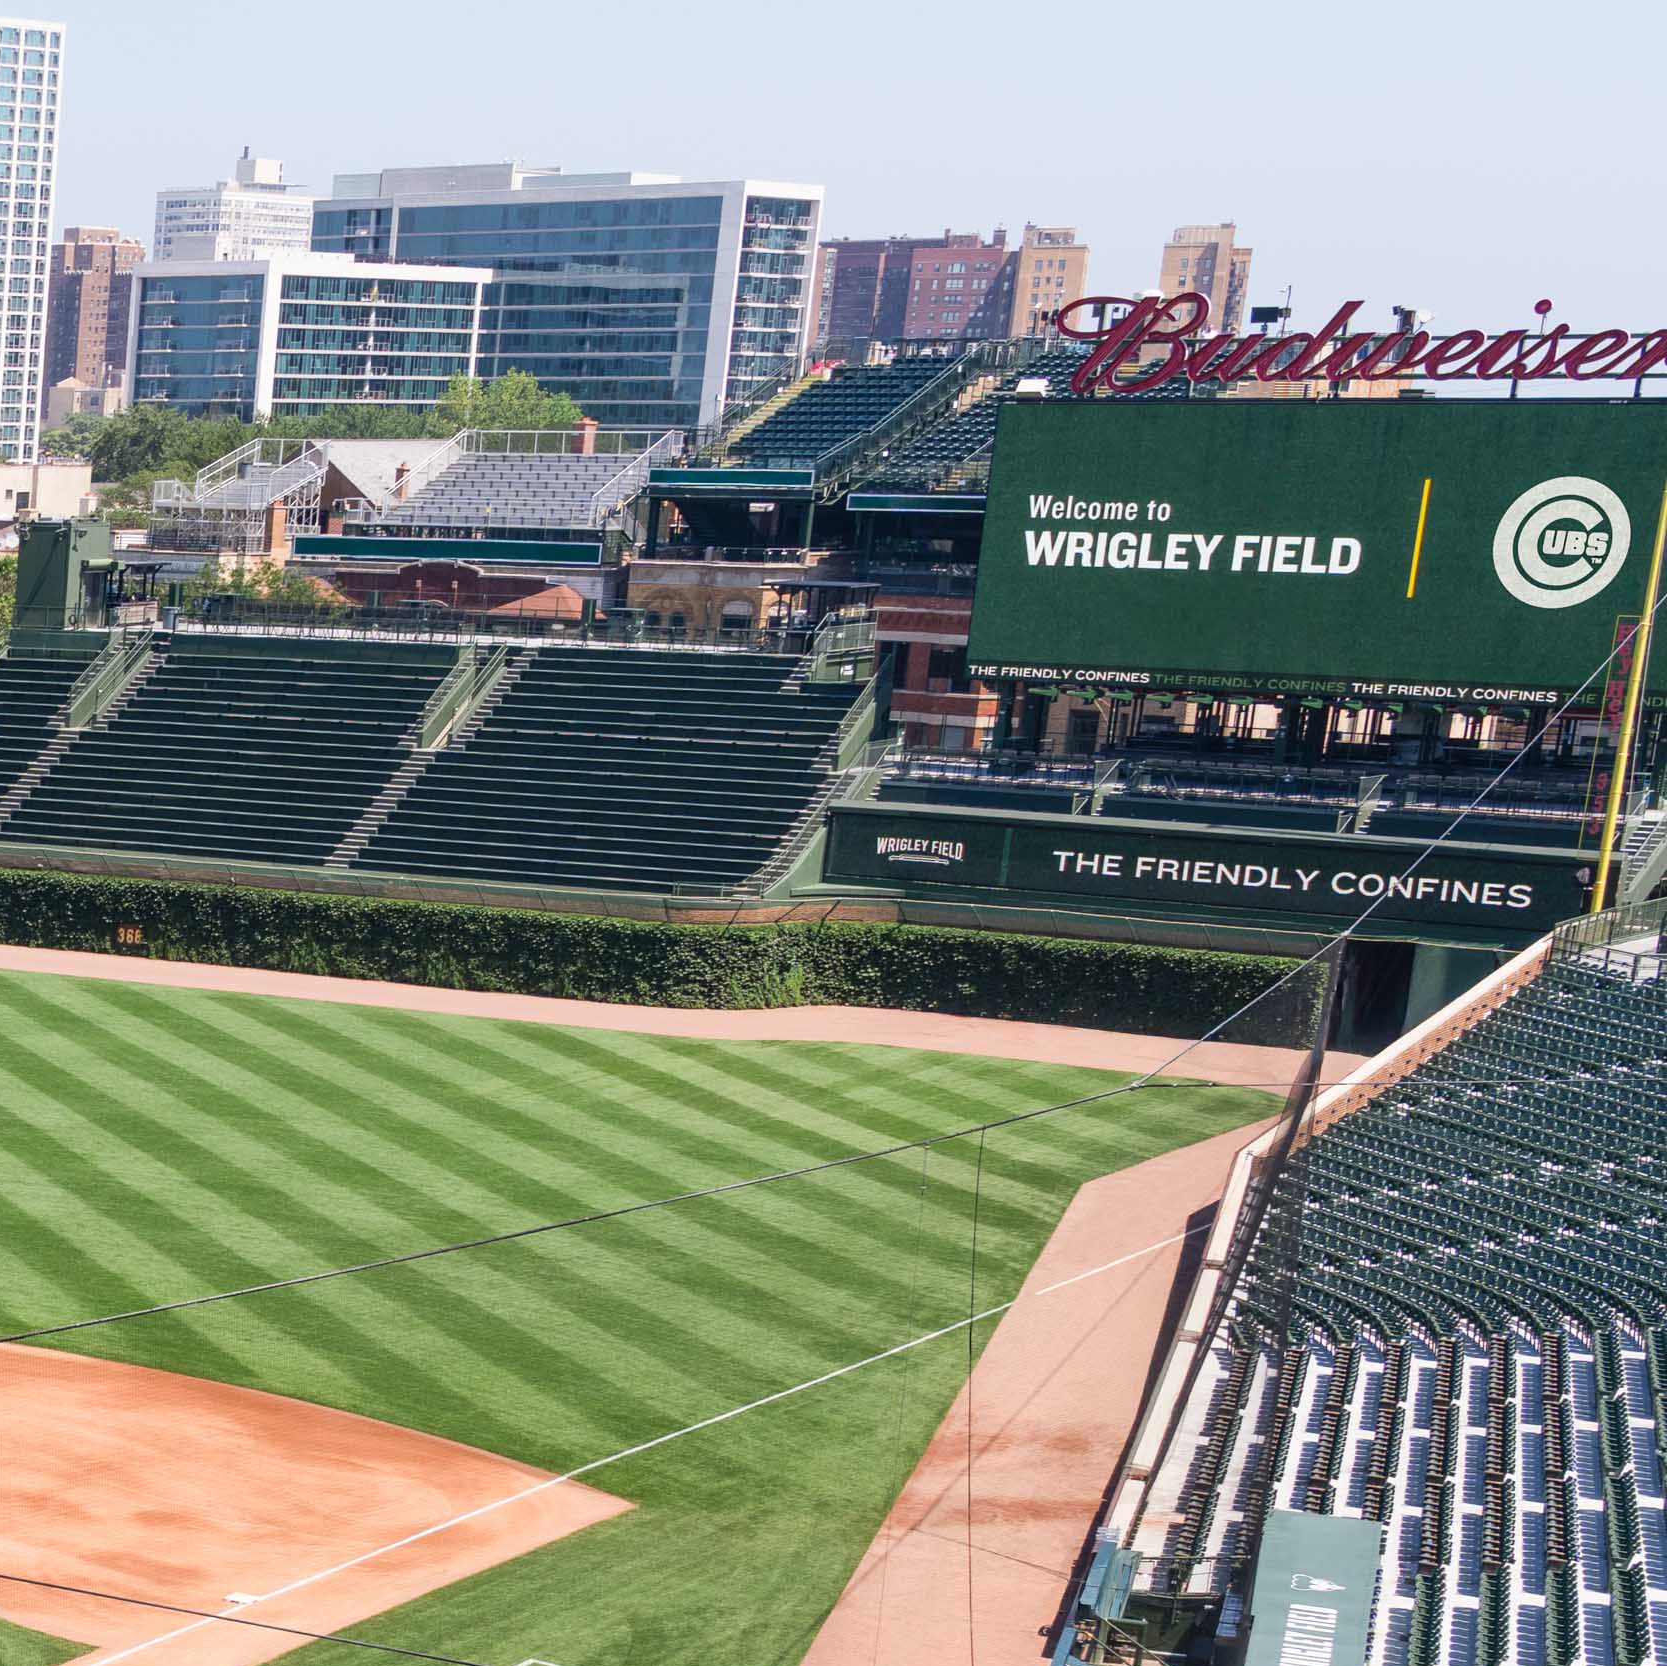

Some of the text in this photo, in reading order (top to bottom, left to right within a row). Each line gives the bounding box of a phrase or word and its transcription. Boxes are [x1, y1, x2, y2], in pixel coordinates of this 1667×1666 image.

[1029, 494, 1172, 522] Welcome to
[1025, 530, 1363, 575] WRIGLEY FIELD
[968, 665, 998, 677] THE
[1001, 667, 1072, 681] FRIENDLY
[1075, 669, 1150, 684] CONFINES
[1187, 675, 1264, 690] FRIENDLY
[1267, 679, 1346, 693] CONFINES
[1351, 682, 1384, 695] THE
[1387, 684, 1467, 699] FRIENDLY
[1471, 687, 1558, 703] CONFINES
[876, 836, 964, 861] WRIGLEY FIELD
[1052, 850, 1533, 908] THE FRIENDLY CONFINES
[1286, 1603, 1339, 1634] FIELD
